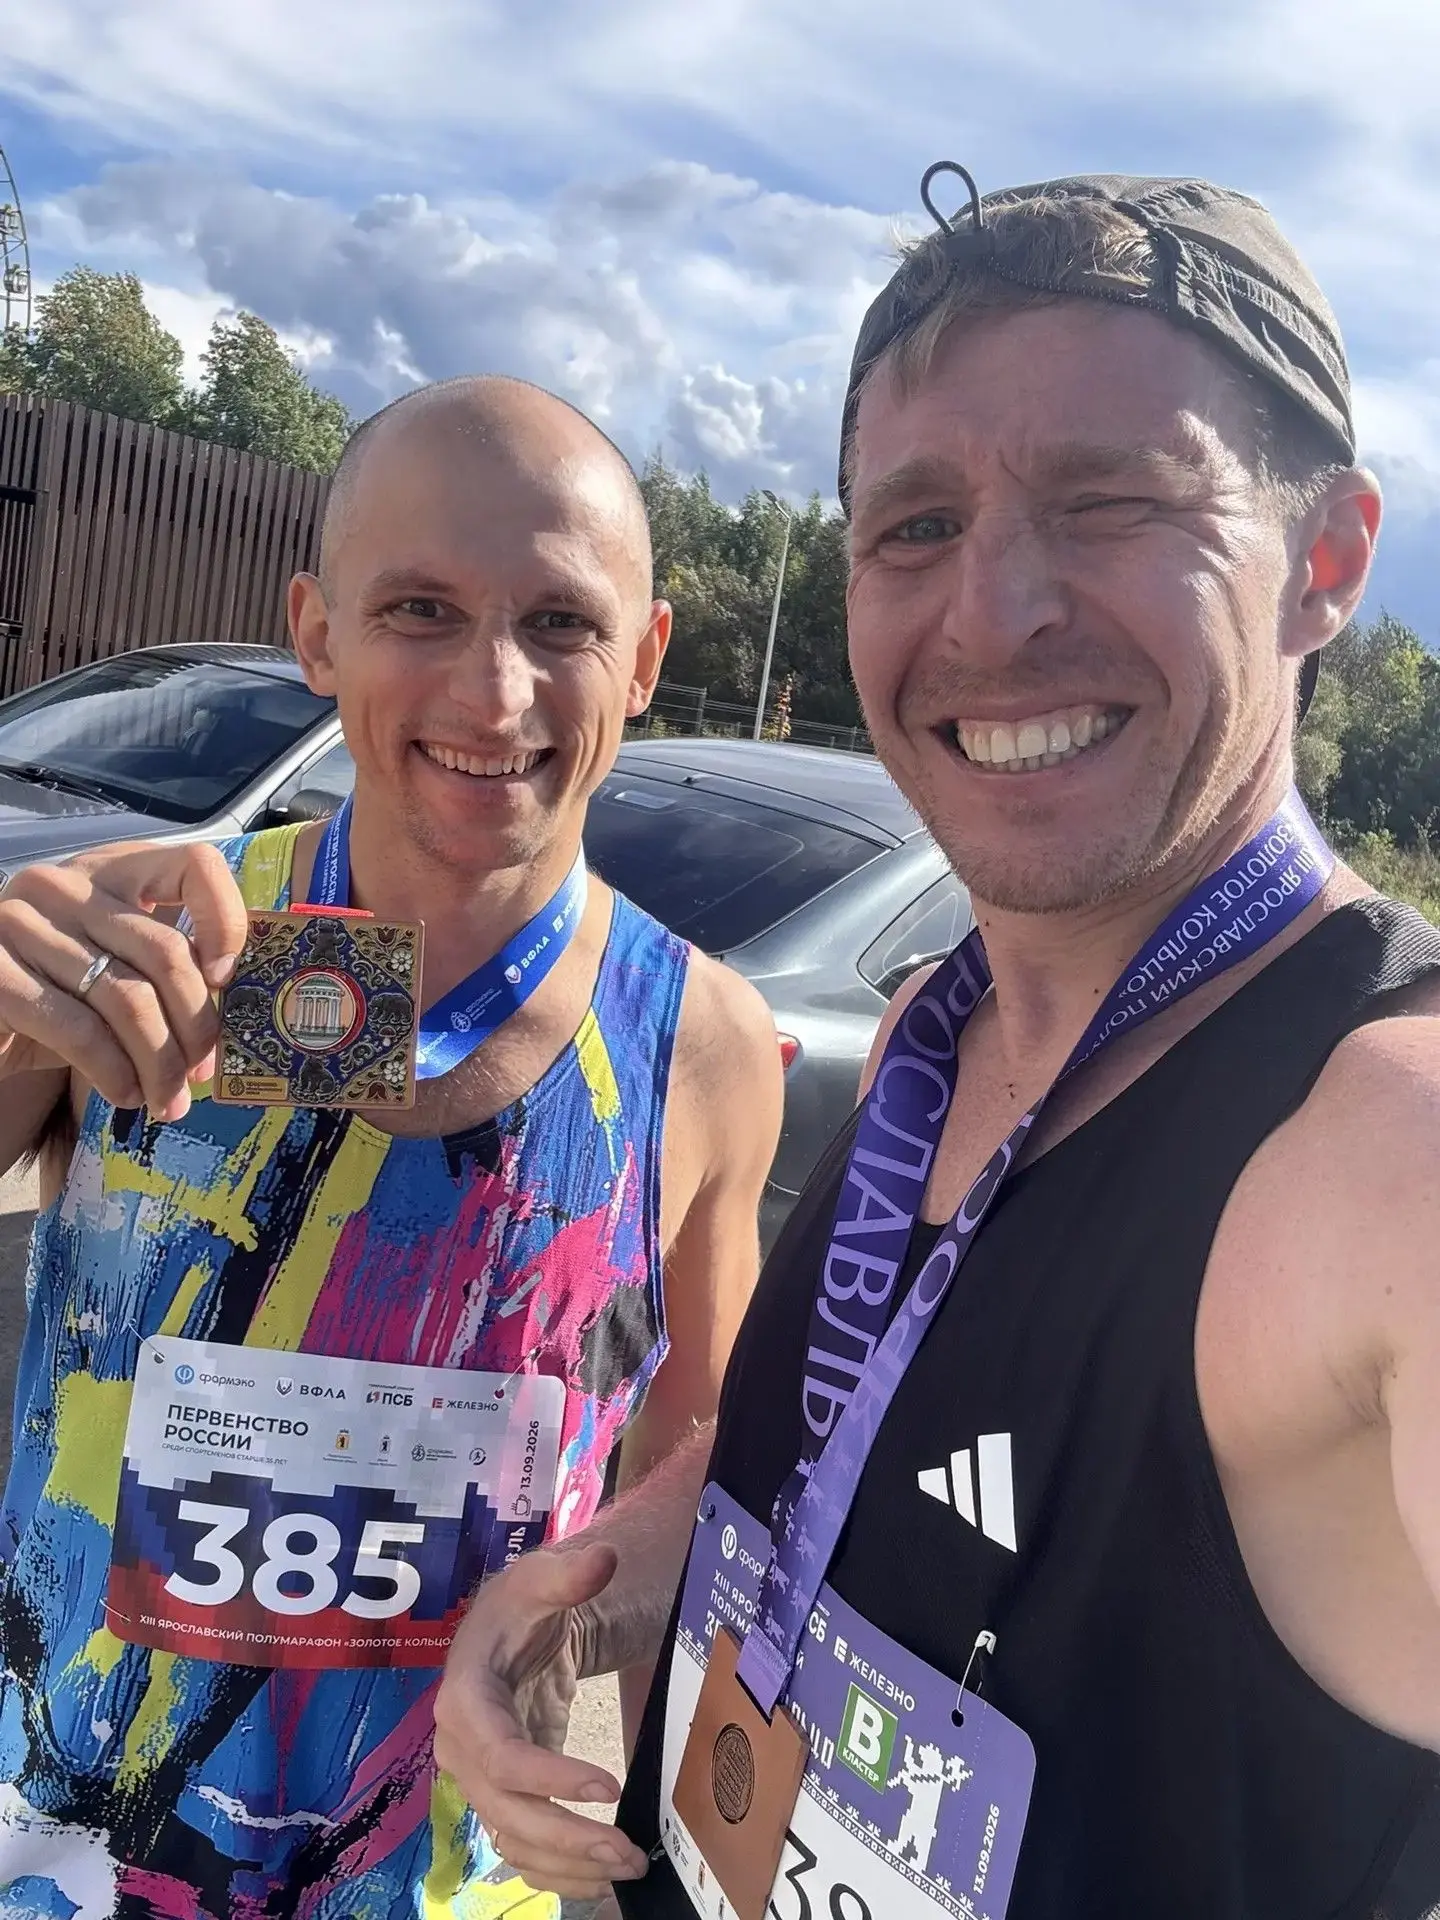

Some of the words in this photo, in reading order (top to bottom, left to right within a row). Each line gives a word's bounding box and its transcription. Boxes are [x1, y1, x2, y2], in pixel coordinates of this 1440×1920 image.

[1150, 864, 1301, 1003] ЯРОСЛАВСКИЙ
[199, 1372, 256, 1388] фармэко
[299, 1384, 347, 1400] ВФЛА
[382, 1392, 414, 1407] ПСБ
[446, 1399, 499, 1412] ЖЕЛЕЗНО
[167, 1404, 309, 1437] ПЕРВЕНСТВО
[164, 1424, 252, 1451] РОССИИ
[520, 1420, 540, 1489] 13.09.2026
[164, 1499, 426, 1620] 385
[713, 1569, 730, 1594] XIII
[139, 1614, 156, 1626] XIII
[158, 1618, 244, 1641] ЯРОСЛАВСКИЙ
[246, 1632, 342, 1647] ПОЛУМАРАФОН
[344, 1638, 402, 1648] «ЗОЛОТОЕ
[808, 1610, 828, 1643] СБ
[849, 1651, 916, 1712] ЖЕЛЕЗНО
[842, 1748, 880, 1784] КЛАСТЕР
[973, 1803, 1001, 1894] 13.09.2026
